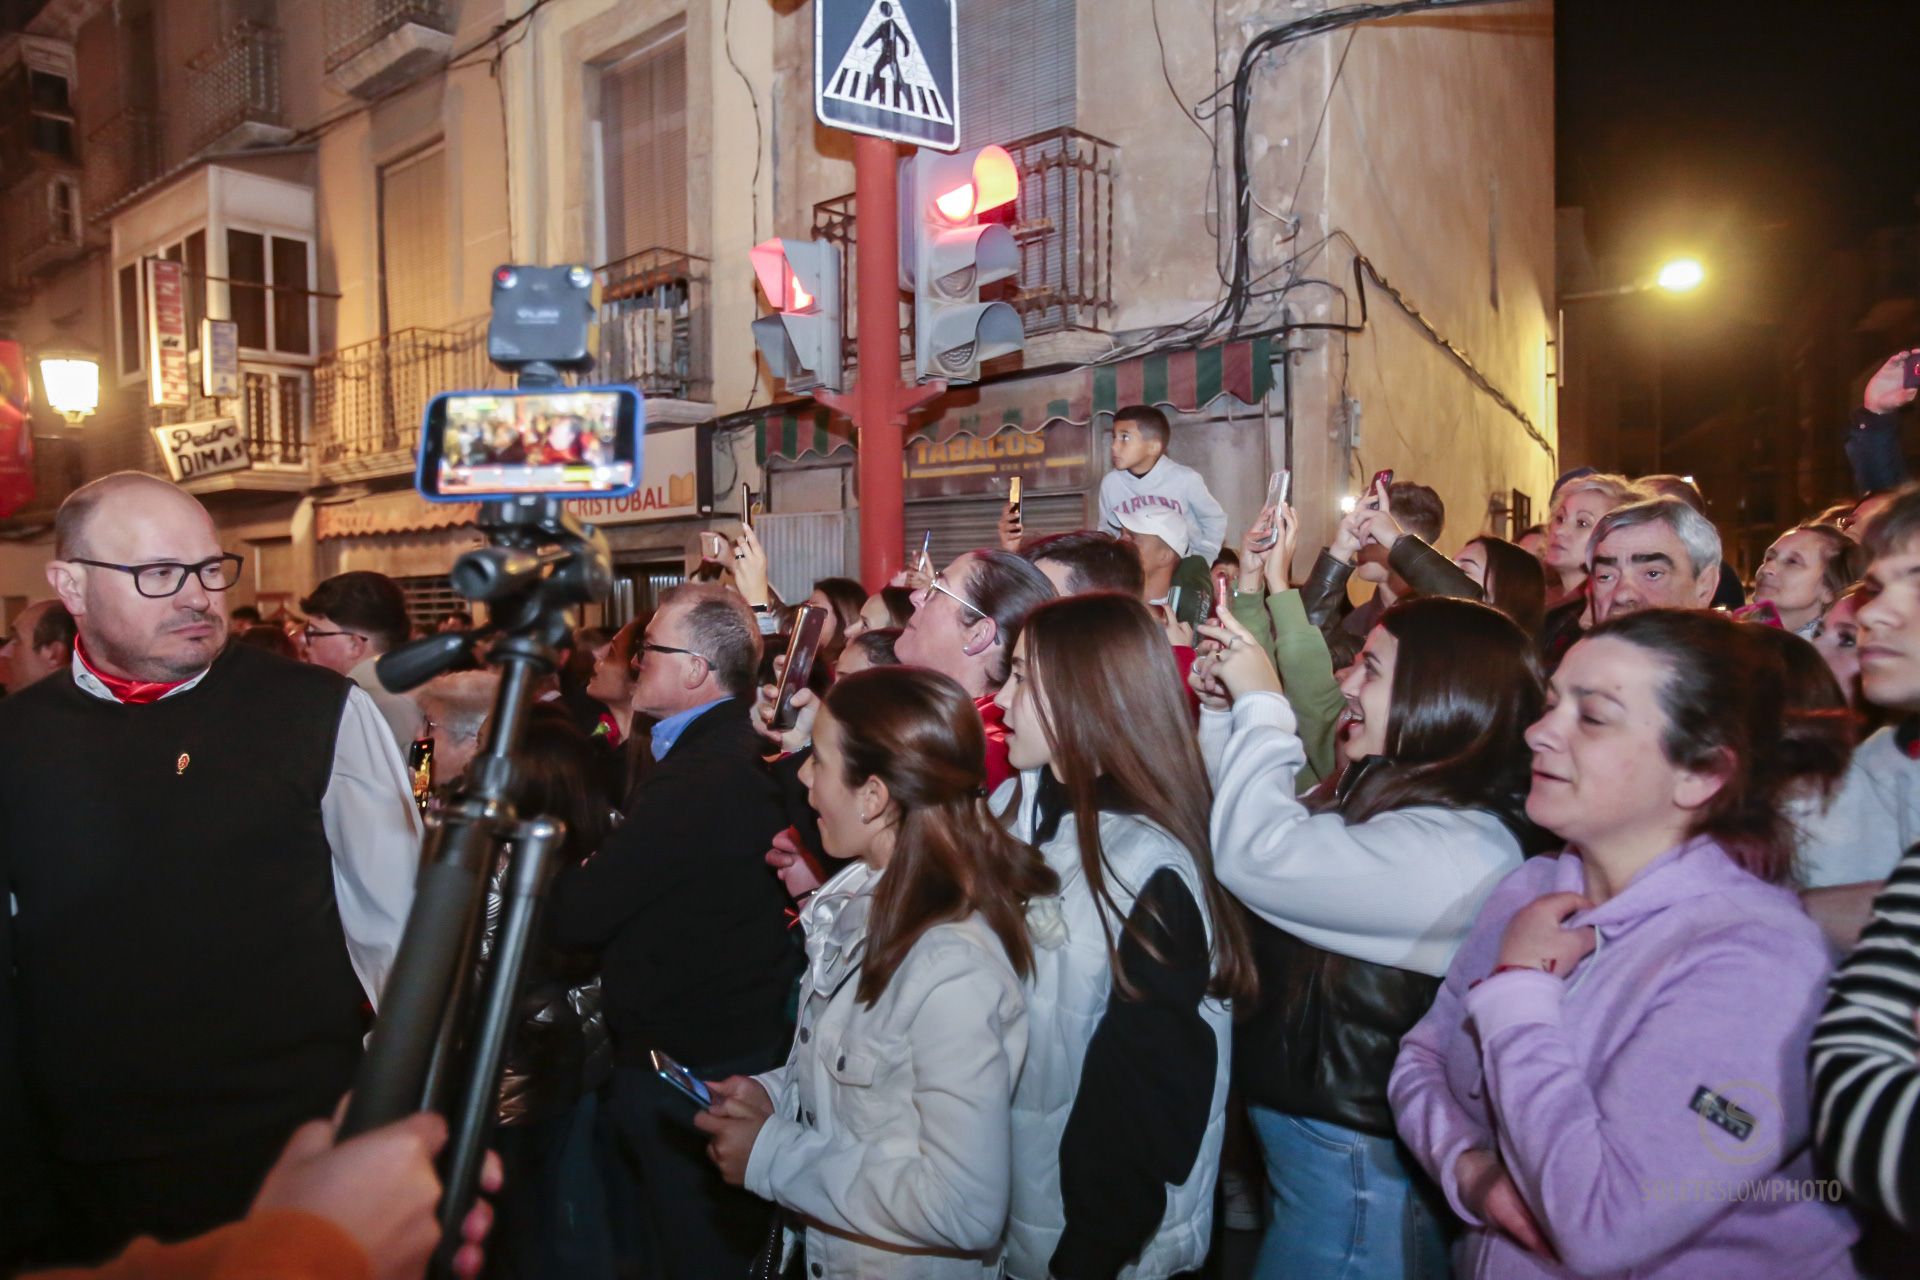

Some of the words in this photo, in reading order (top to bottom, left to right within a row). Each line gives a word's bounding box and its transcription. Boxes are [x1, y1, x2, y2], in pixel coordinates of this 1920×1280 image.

[171, 425, 238, 453] Pedro
[915, 431, 1046, 465] TABACOS
[566, 487, 669, 517] CRISTOBAL
